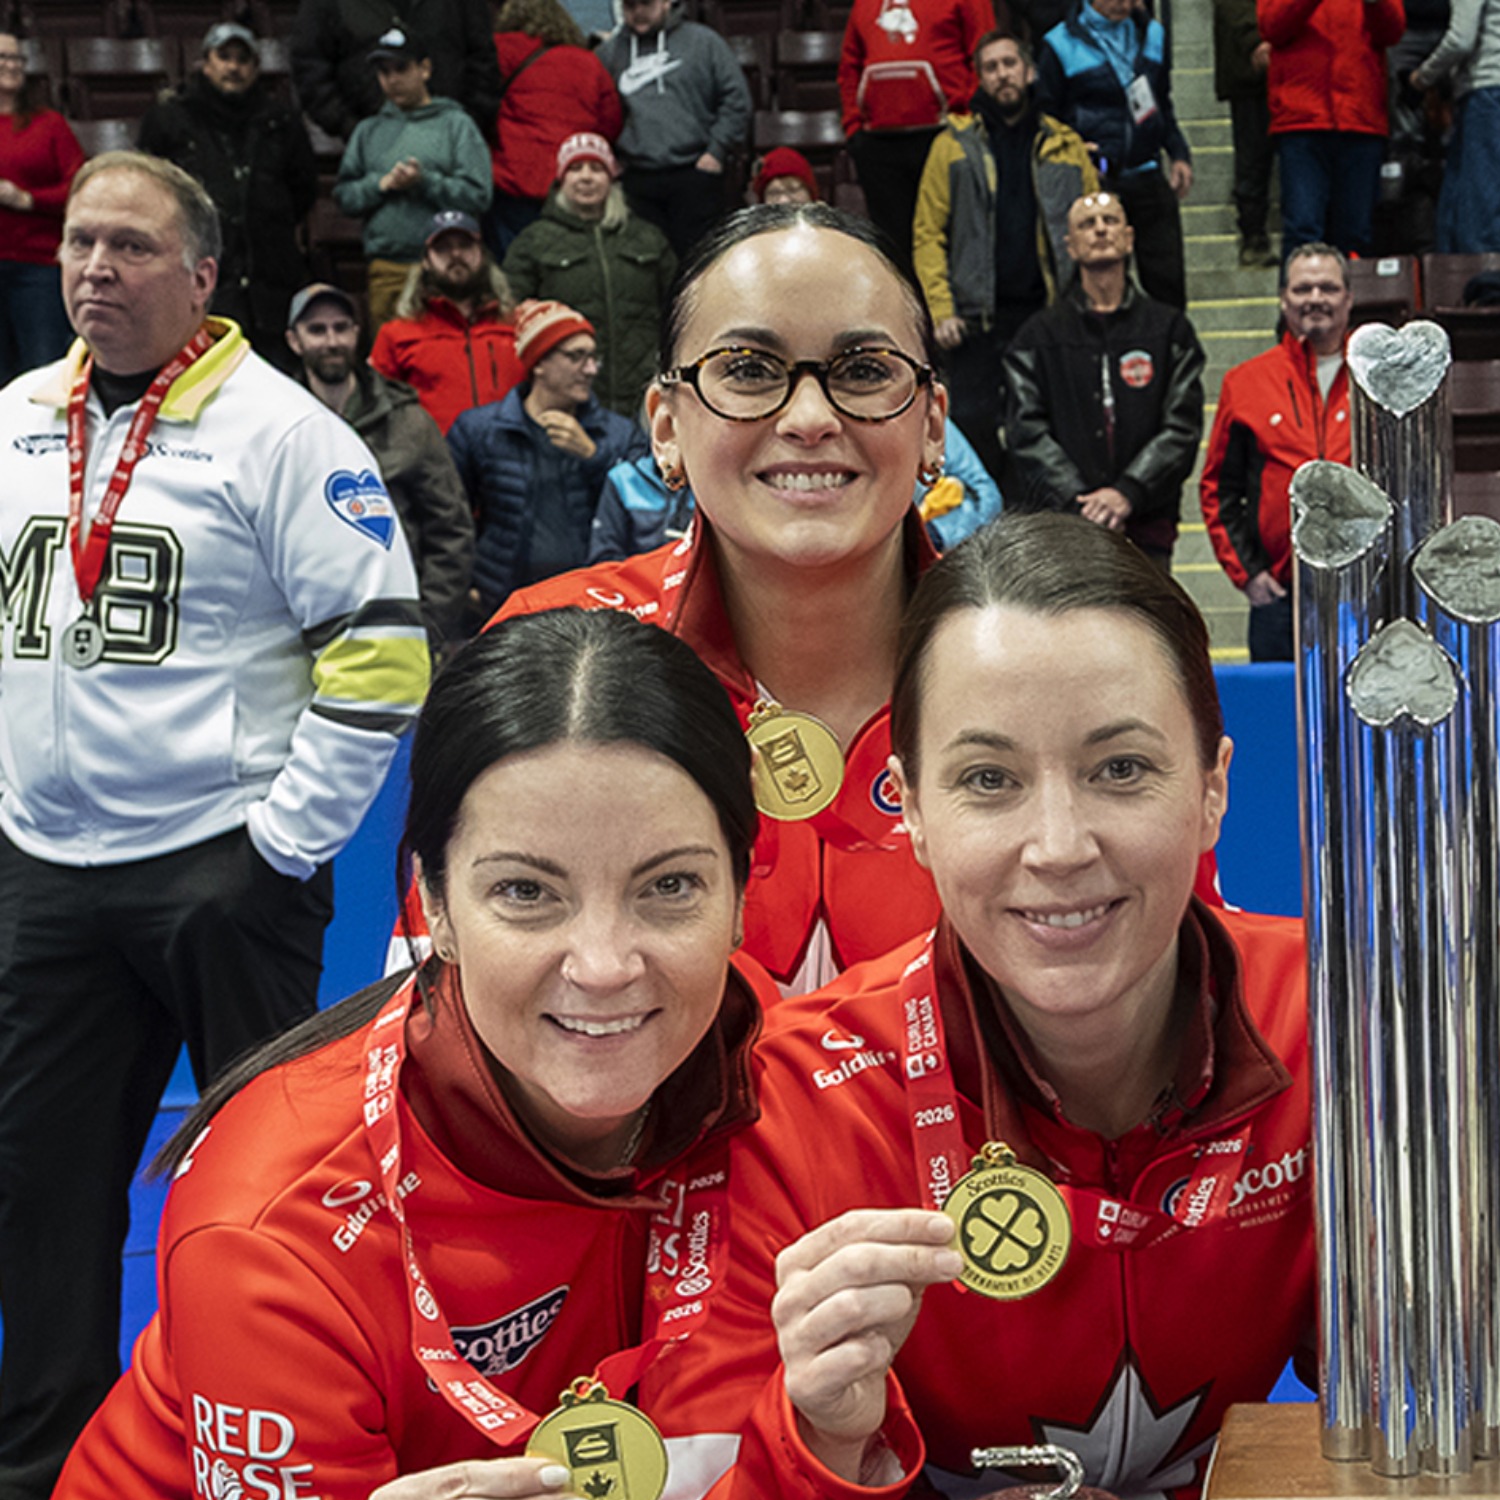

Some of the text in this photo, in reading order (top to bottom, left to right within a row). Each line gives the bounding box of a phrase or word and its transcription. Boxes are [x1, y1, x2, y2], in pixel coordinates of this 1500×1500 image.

[905, 999, 923, 1053] CURLING
[920, 996, 938, 1049] CANADA
[914, 1104, 955, 1128] 2026
[1206, 1140, 1242, 1155] 2026
[966, 1171, 1027, 1198] Scotties
[662, 1300, 704, 1323] 2026
[192, 1393, 297, 1461] RED
